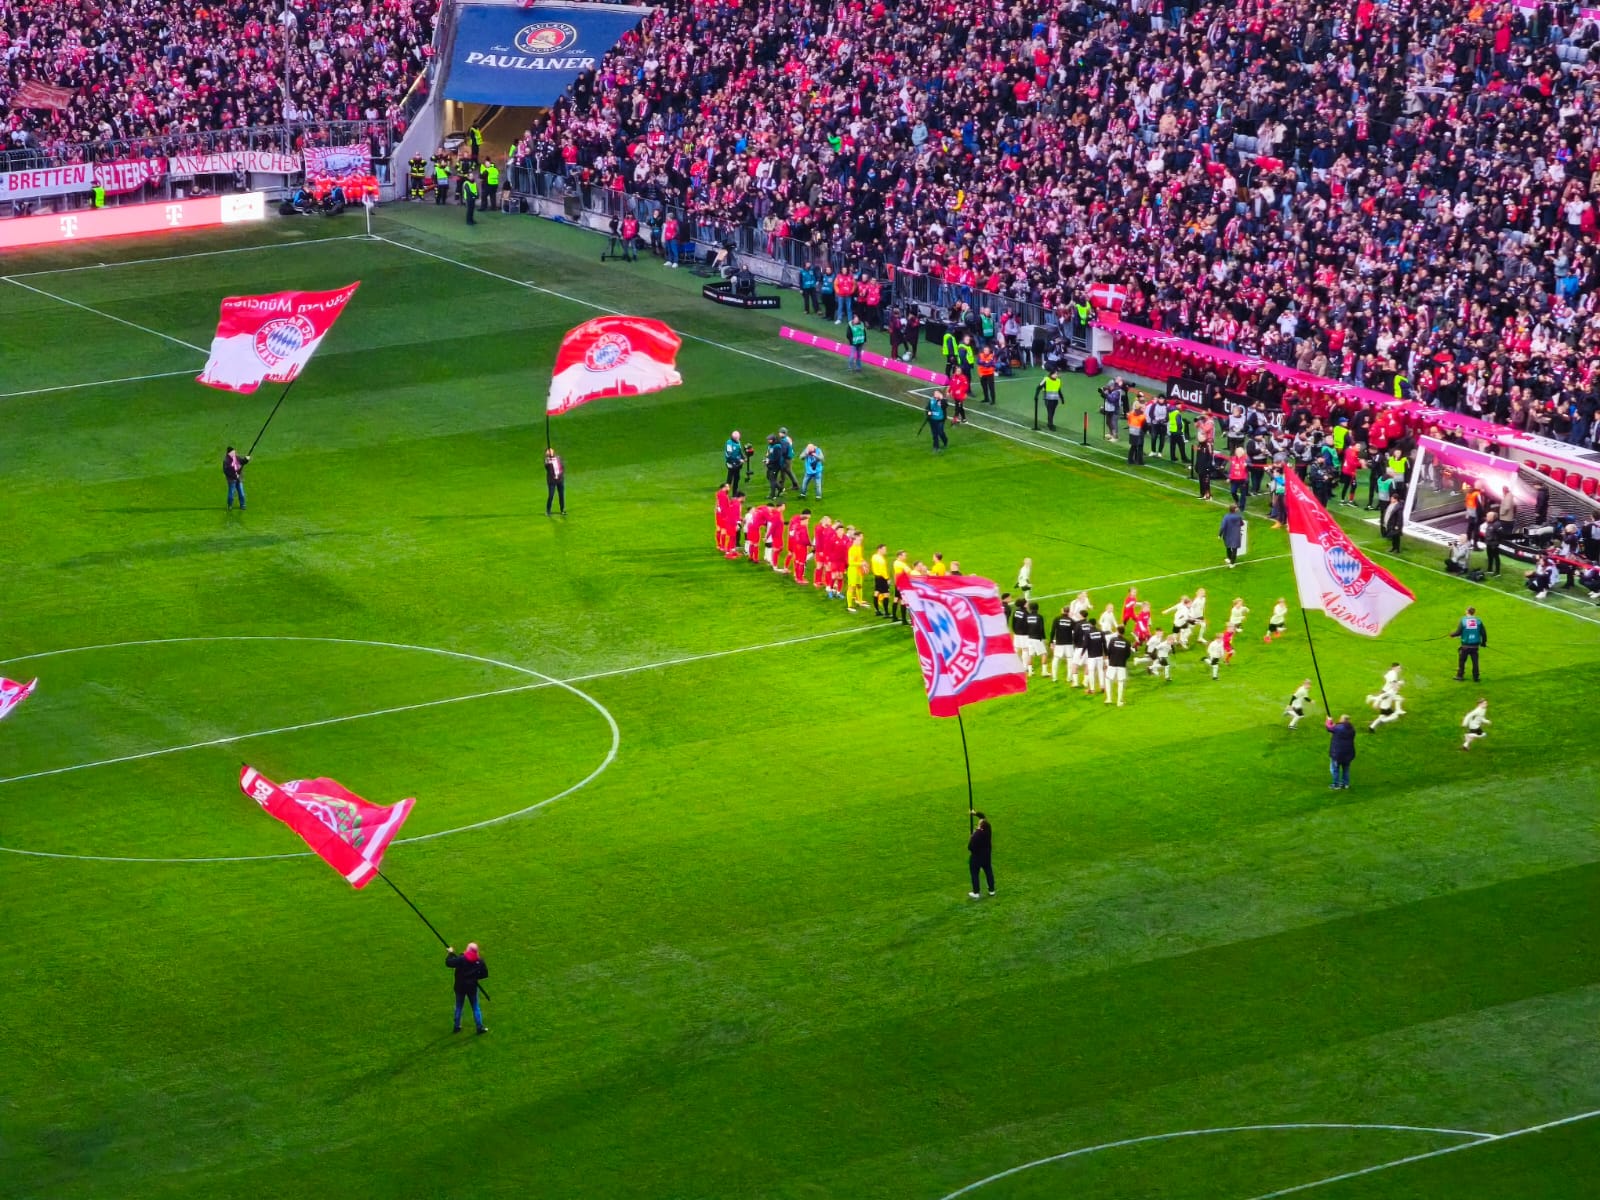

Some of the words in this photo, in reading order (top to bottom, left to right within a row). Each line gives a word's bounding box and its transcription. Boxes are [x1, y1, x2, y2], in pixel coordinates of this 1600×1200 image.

[464, 51, 596, 70] PAULANER
[175, 151, 300, 173] ANZENKIRCHEN
[8, 166, 86, 191] BRETTEN
[94, 160, 149, 190] SELTERS
[1170, 383, 1203, 405] Audi
